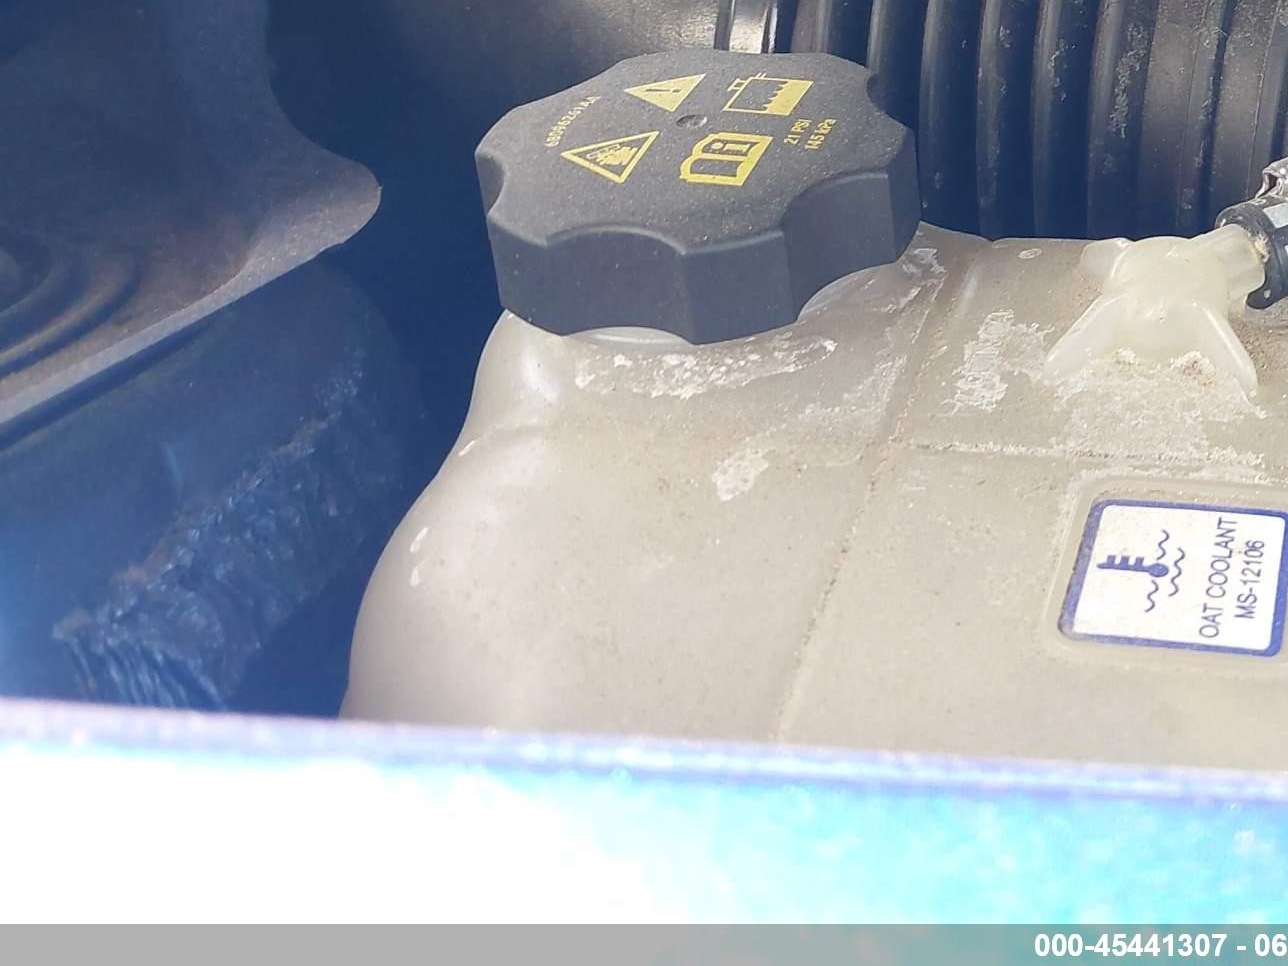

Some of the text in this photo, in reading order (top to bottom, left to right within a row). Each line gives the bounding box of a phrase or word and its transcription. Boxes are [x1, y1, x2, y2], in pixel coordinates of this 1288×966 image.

[783, 118, 813, 145] 21 PSI
[804, 134, 825, 150] 145
[1198, 516, 1239, 639] OAT COOLANT
[1234, 539, 1266, 619] MS-12106
